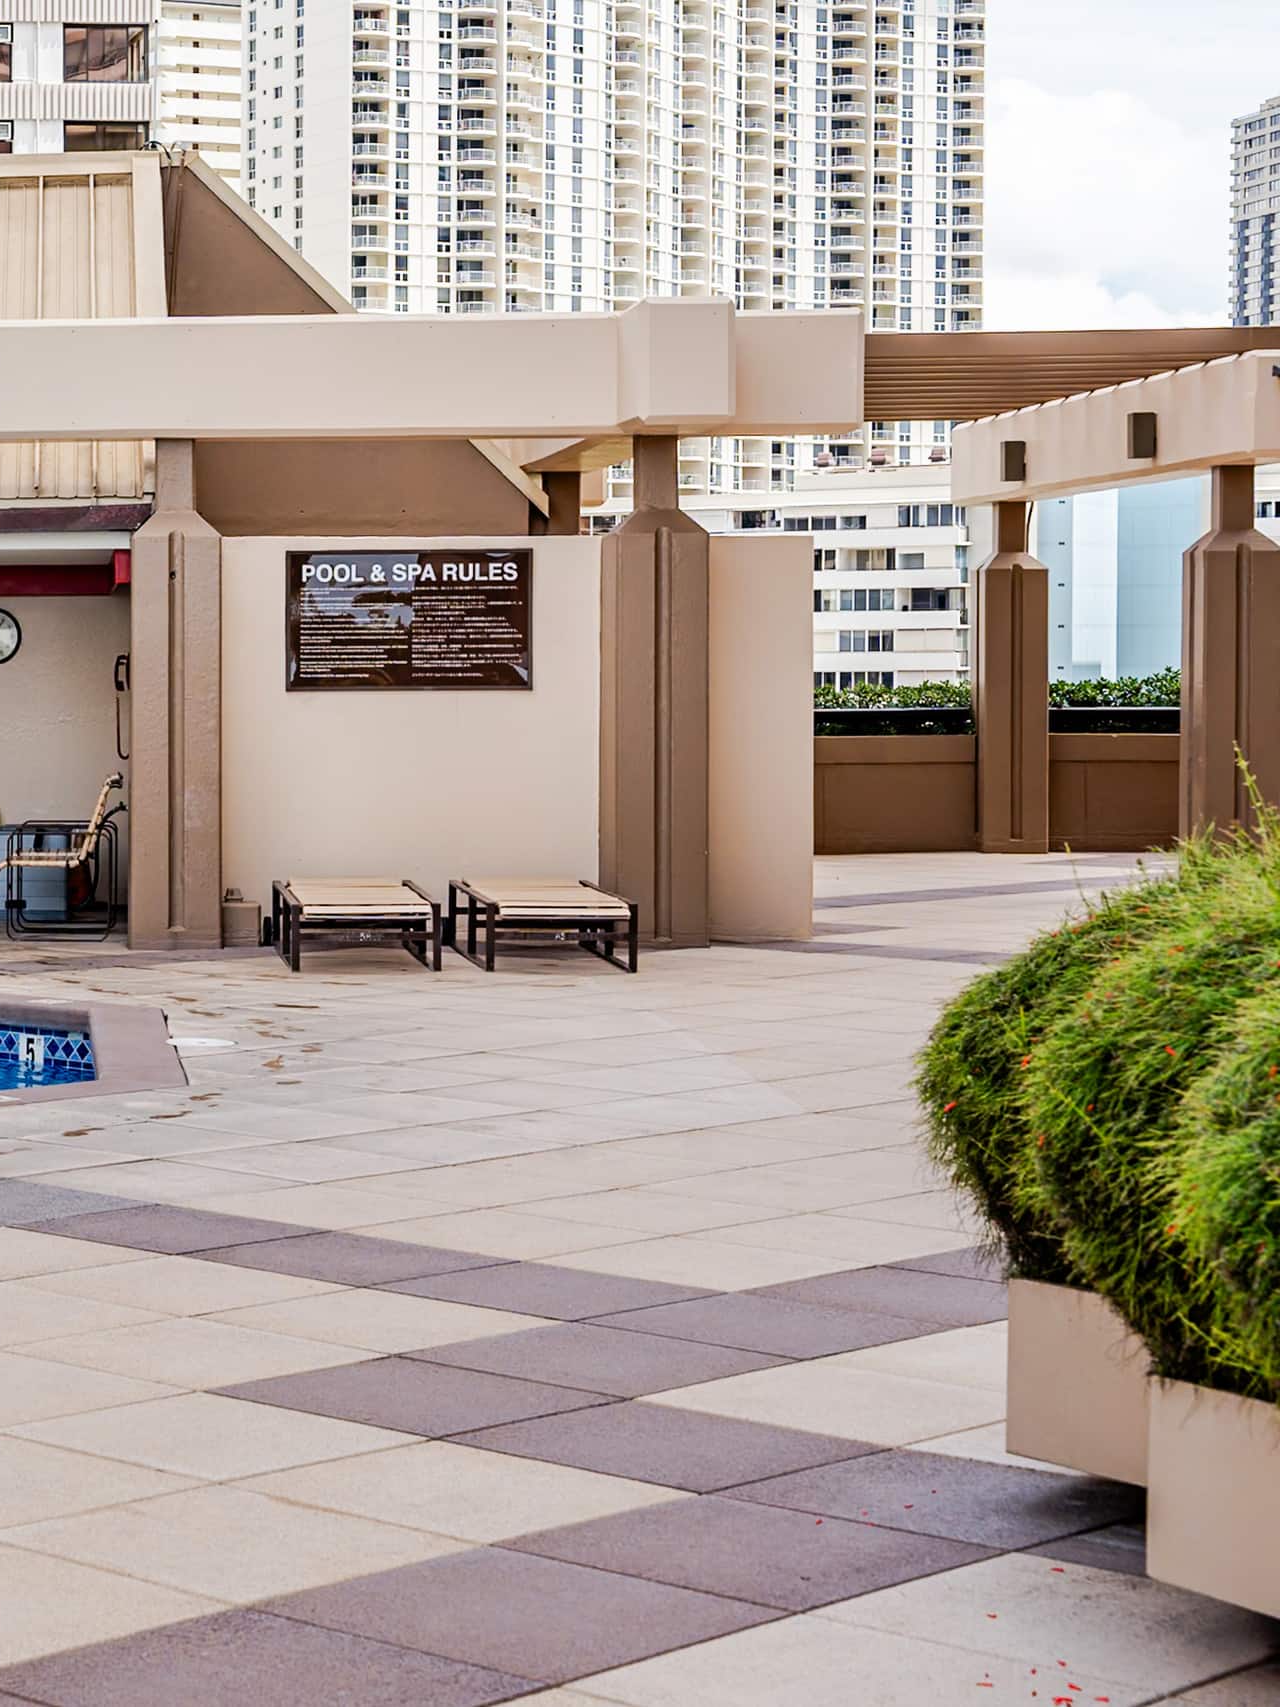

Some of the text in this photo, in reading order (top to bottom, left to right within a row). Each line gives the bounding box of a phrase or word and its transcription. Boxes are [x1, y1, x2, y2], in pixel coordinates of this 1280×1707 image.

[302, 562, 518, 582] POOL & SPA RULES
[26, 1038, 35, 1068] 5
